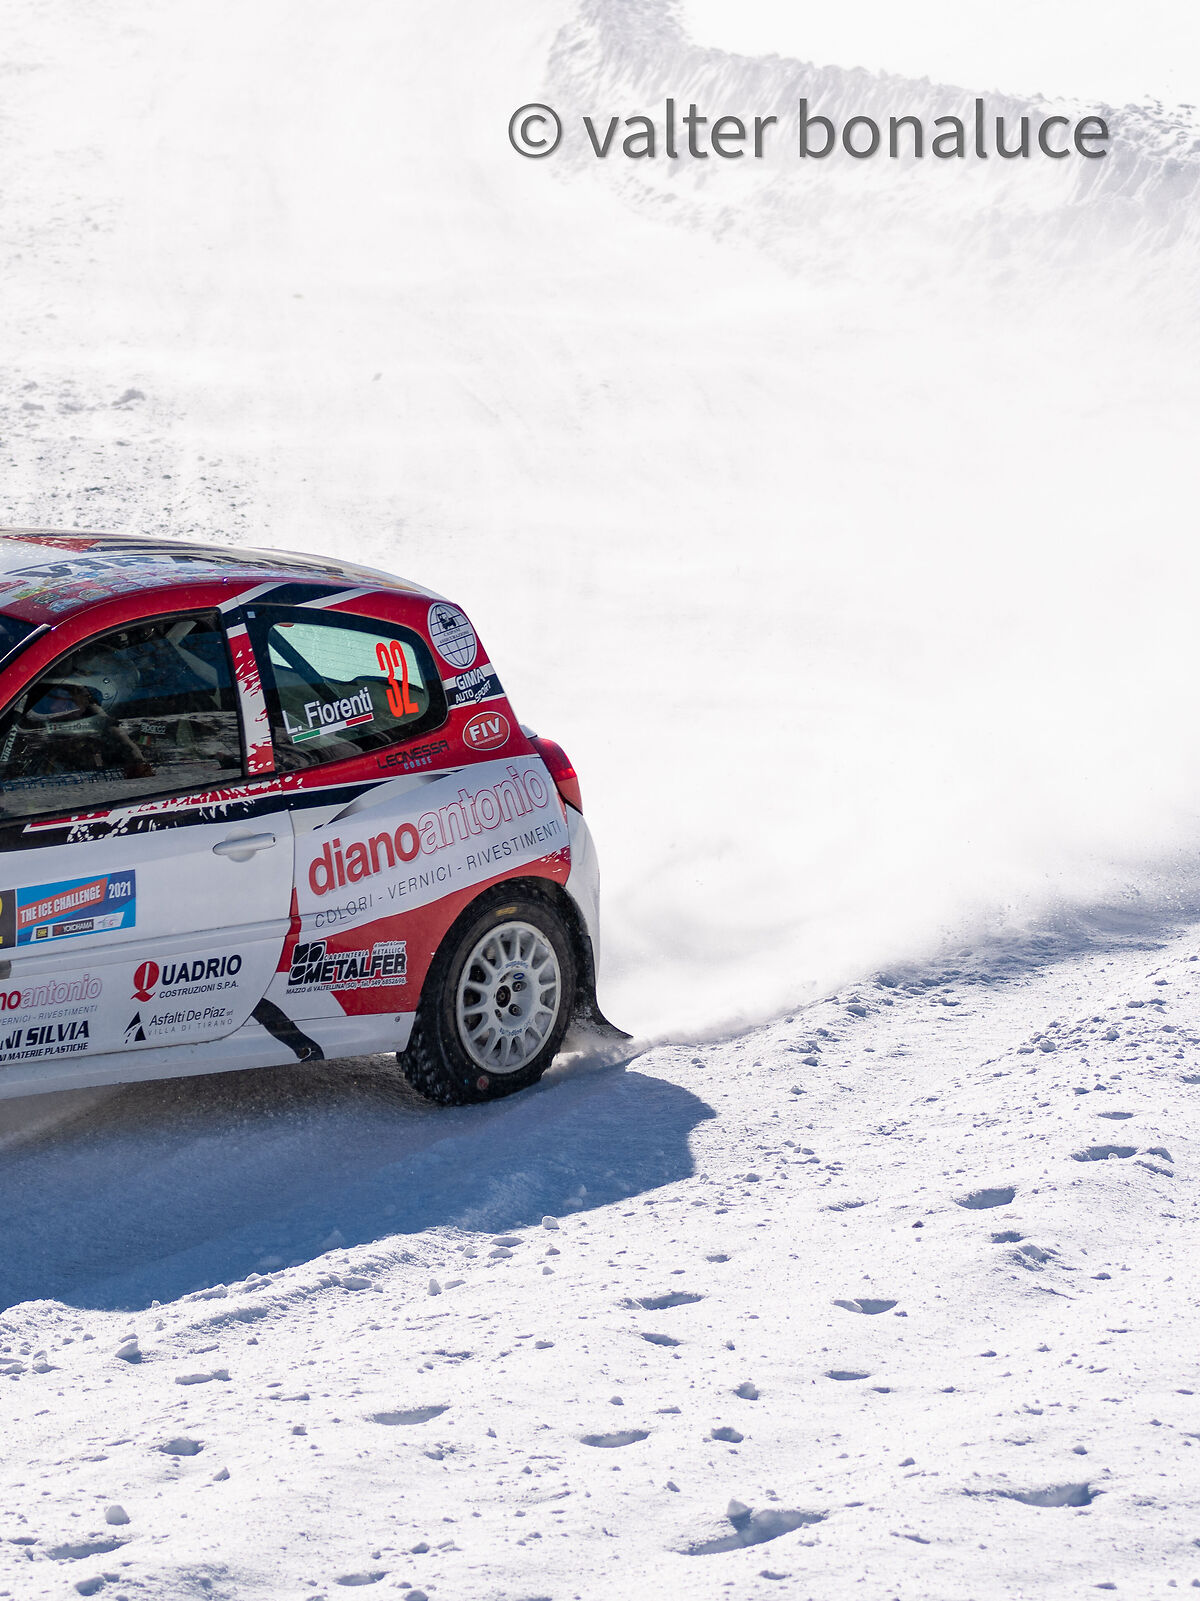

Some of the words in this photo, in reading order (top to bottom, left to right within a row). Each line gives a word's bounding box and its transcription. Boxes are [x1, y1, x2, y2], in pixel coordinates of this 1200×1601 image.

[375, 640, 419, 718] 32
[455, 668, 486, 691] GIMA
[455, 689, 474, 704] AUTO
[474, 680, 492, 704] SPORT
[304, 686, 374, 728] Fiorenti
[469, 717, 500, 742] FIV
[377, 740, 450, 770] LEONESSA
[315, 896, 373, 928] COLORI
[388, 864, 452, 900] VERNICI
[466, 819, 562, 871] RIVESTIMENTI
[108, 881, 131, 899] 2021
[20, 907, 37, 923] THE
[38, 902, 53, 917] ICE
[54, 885, 100, 912] CHALLENGE
[63, 919, 93, 932] YOKOHAMA
[324, 950, 369, 960] CARPENTERIA
[372, 947, 406, 955] METALLICA
[130, 954, 242, 1002] QUADRIO
[305, 953, 407, 984] METALFER
[159, 984, 215, 999] COSTRUZIONI
[216, 980, 239, 991] S.P.A.
[286, 987, 306, 995] MAZZO
[313, 982, 345, 992] VALTELLINA
[39, 1005, 98, 1020] RIVESTIMENTI
[149, 1011, 186, 1027] Asfalti
[186, 1010, 202, 1022] De
[203, 1006, 226, 1019] Piaz
[25, 1020, 90, 1046] SILVIA
[147, 1025, 176, 1036] VILLA
[182, 1024, 191, 1032] DI
[198, 1018, 233, 1030] TIRANO
[7, 1049, 43, 1061] MATERIE
[44, 1042, 89, 1056] PLASTICHE
